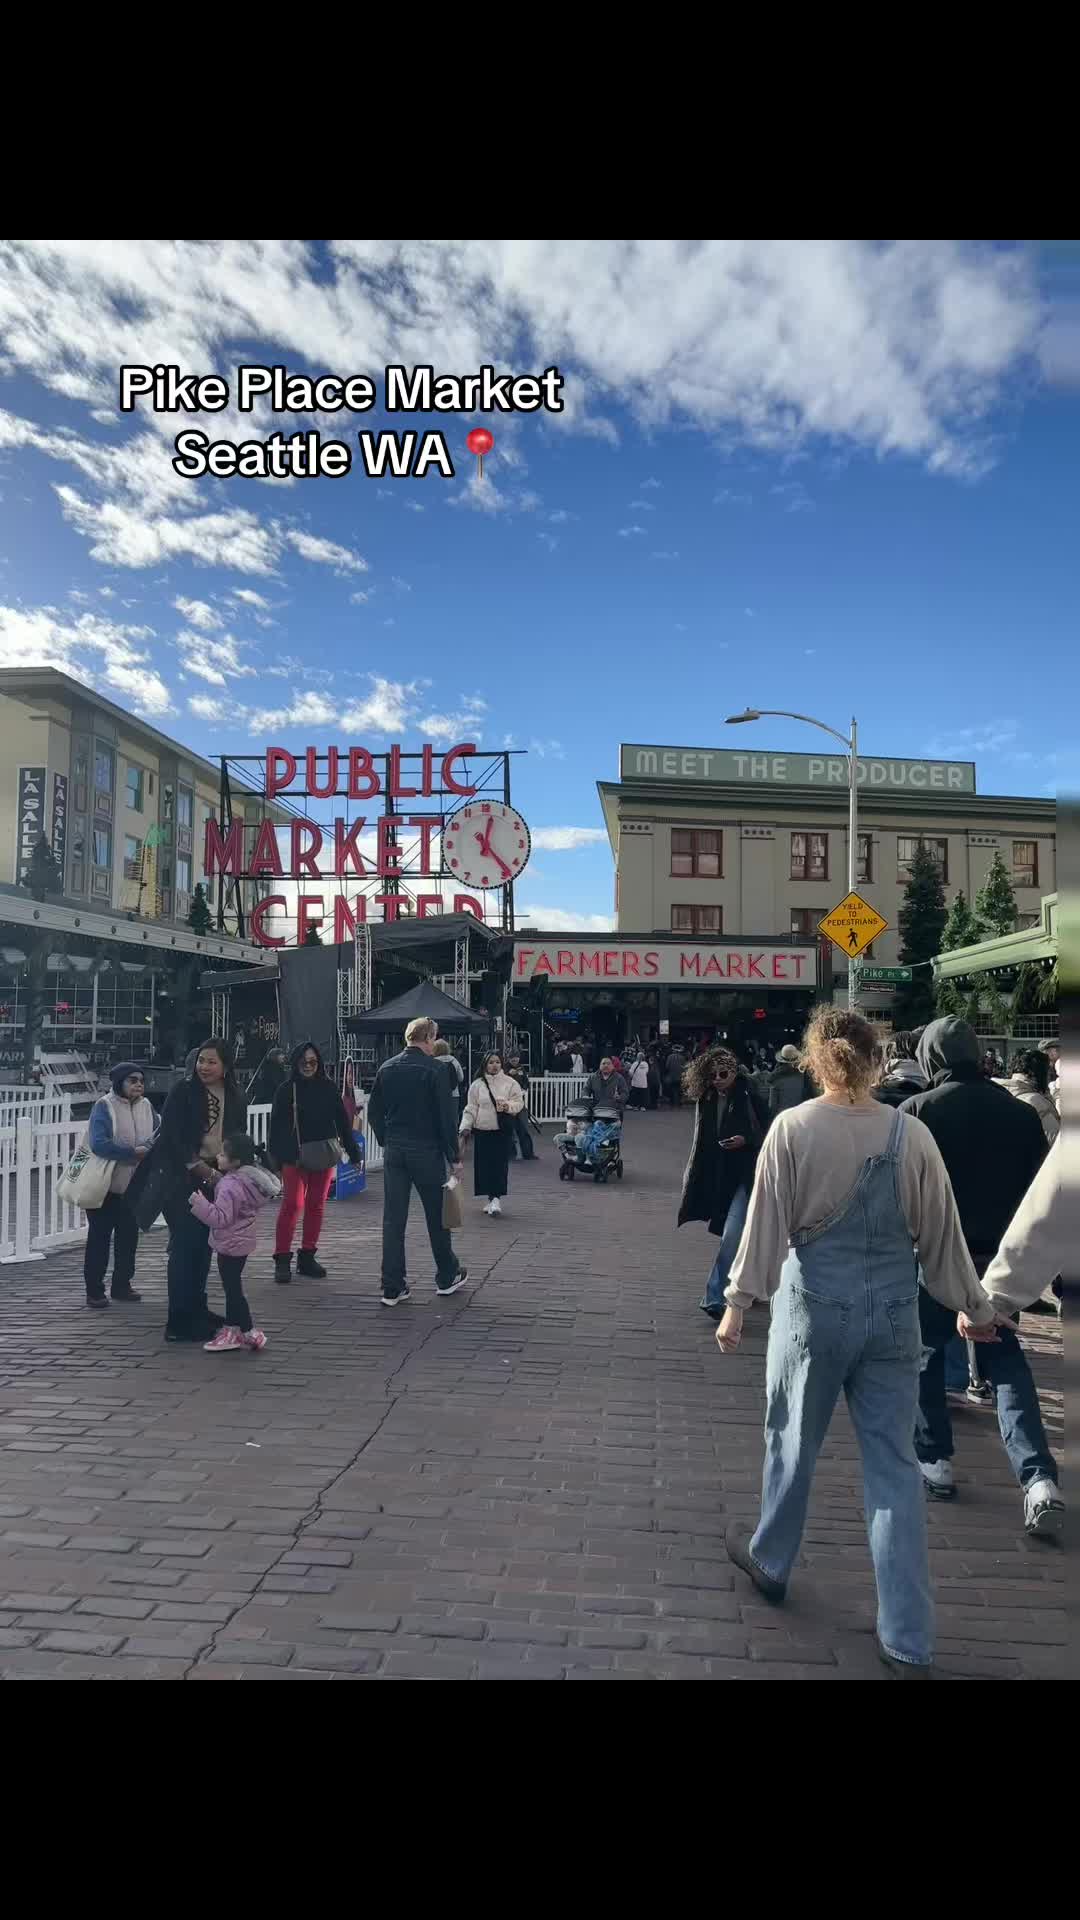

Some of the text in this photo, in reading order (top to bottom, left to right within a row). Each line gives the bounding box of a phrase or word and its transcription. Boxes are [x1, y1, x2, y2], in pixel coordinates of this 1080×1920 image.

[265, 743, 477, 799] PUBLIC
[635, 750, 964, 788] MEET THE PRODUCER
[204, 816, 445, 878] MARKET
[827, 918, 878, 926] PEDESTRIANS
[517, 950, 807, 978] FARMERS MARKET
[863, 968, 883, 978] Pike
